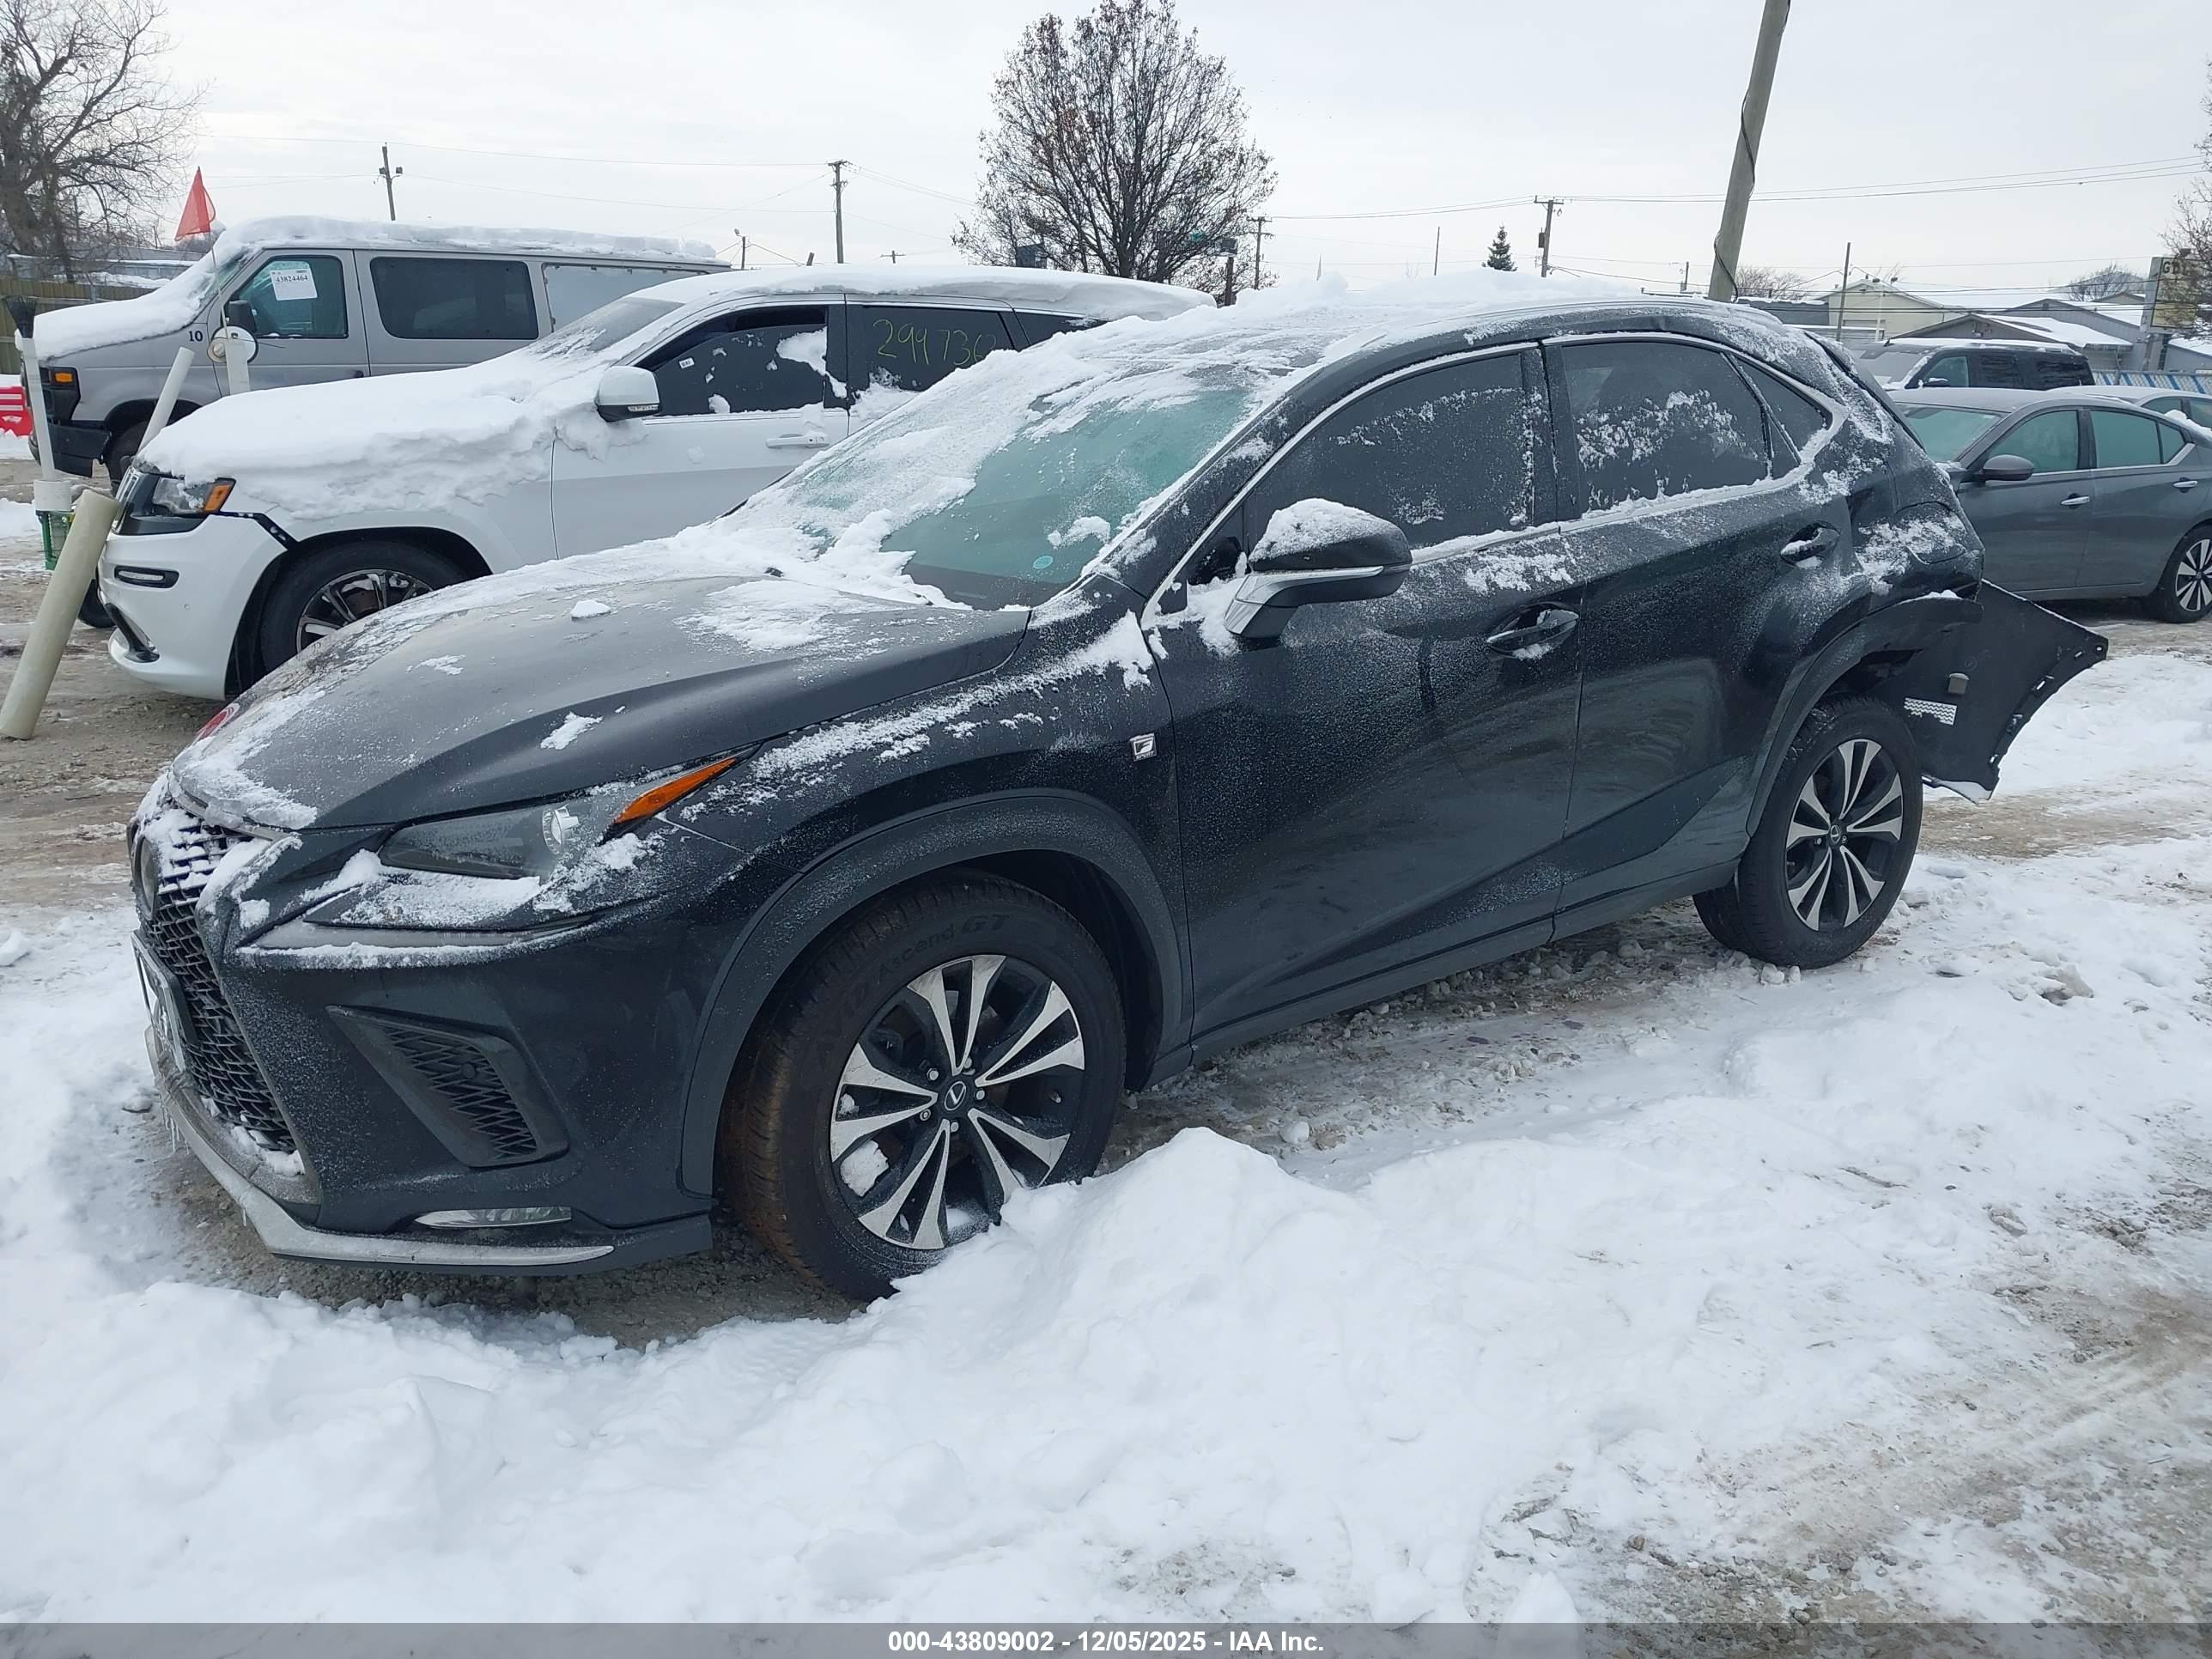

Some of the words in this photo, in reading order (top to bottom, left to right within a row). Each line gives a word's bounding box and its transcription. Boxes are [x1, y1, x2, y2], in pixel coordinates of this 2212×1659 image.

[275, 274, 308, 283] 43824464
[188, 330, 204, 342] 10
[878, 923, 955, 980] Ascend
[960, 914, 1012, 935] GT
